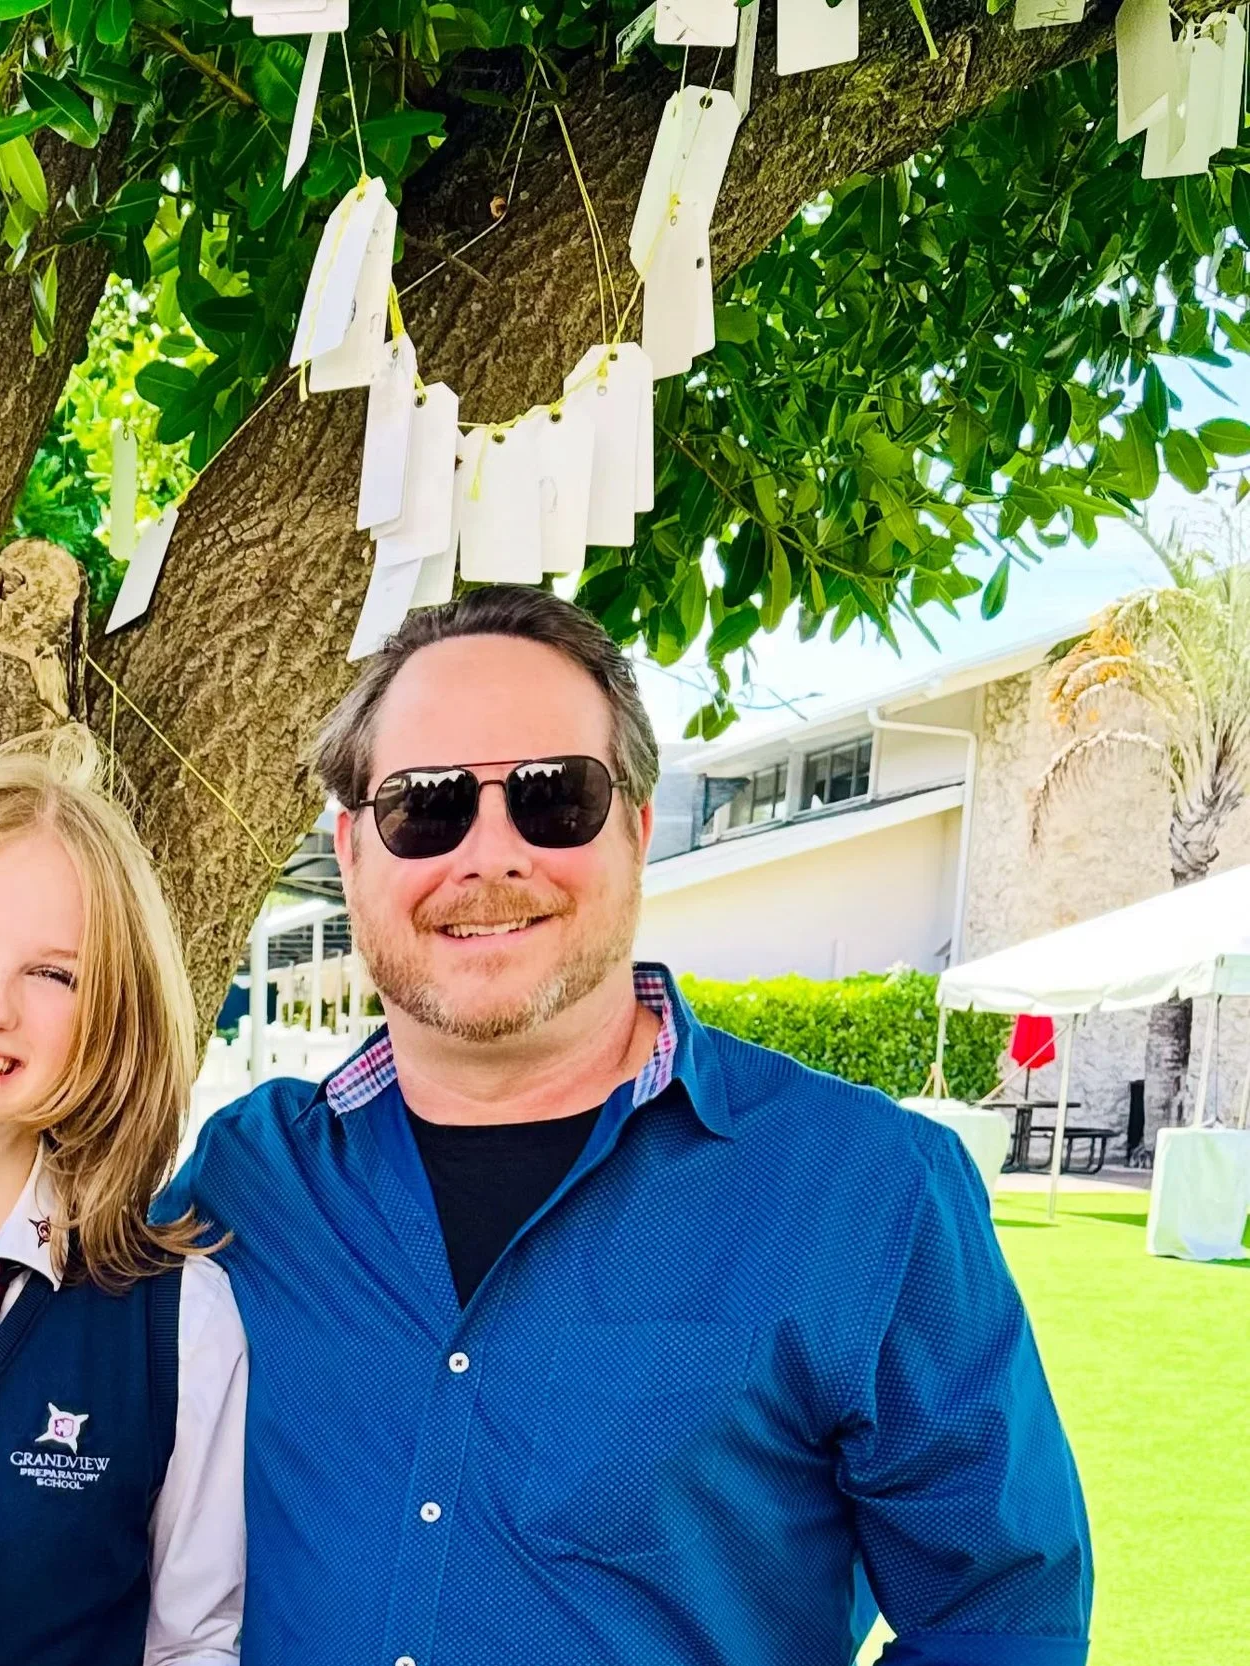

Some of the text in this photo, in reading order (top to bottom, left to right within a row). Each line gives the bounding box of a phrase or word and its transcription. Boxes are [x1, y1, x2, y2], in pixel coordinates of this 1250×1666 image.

[10, 1451, 110, 1471] GRANDVIEW
[20, 1467, 100, 1482] PREPARATORY
[36, 1478, 84, 1490] SCHOOL
